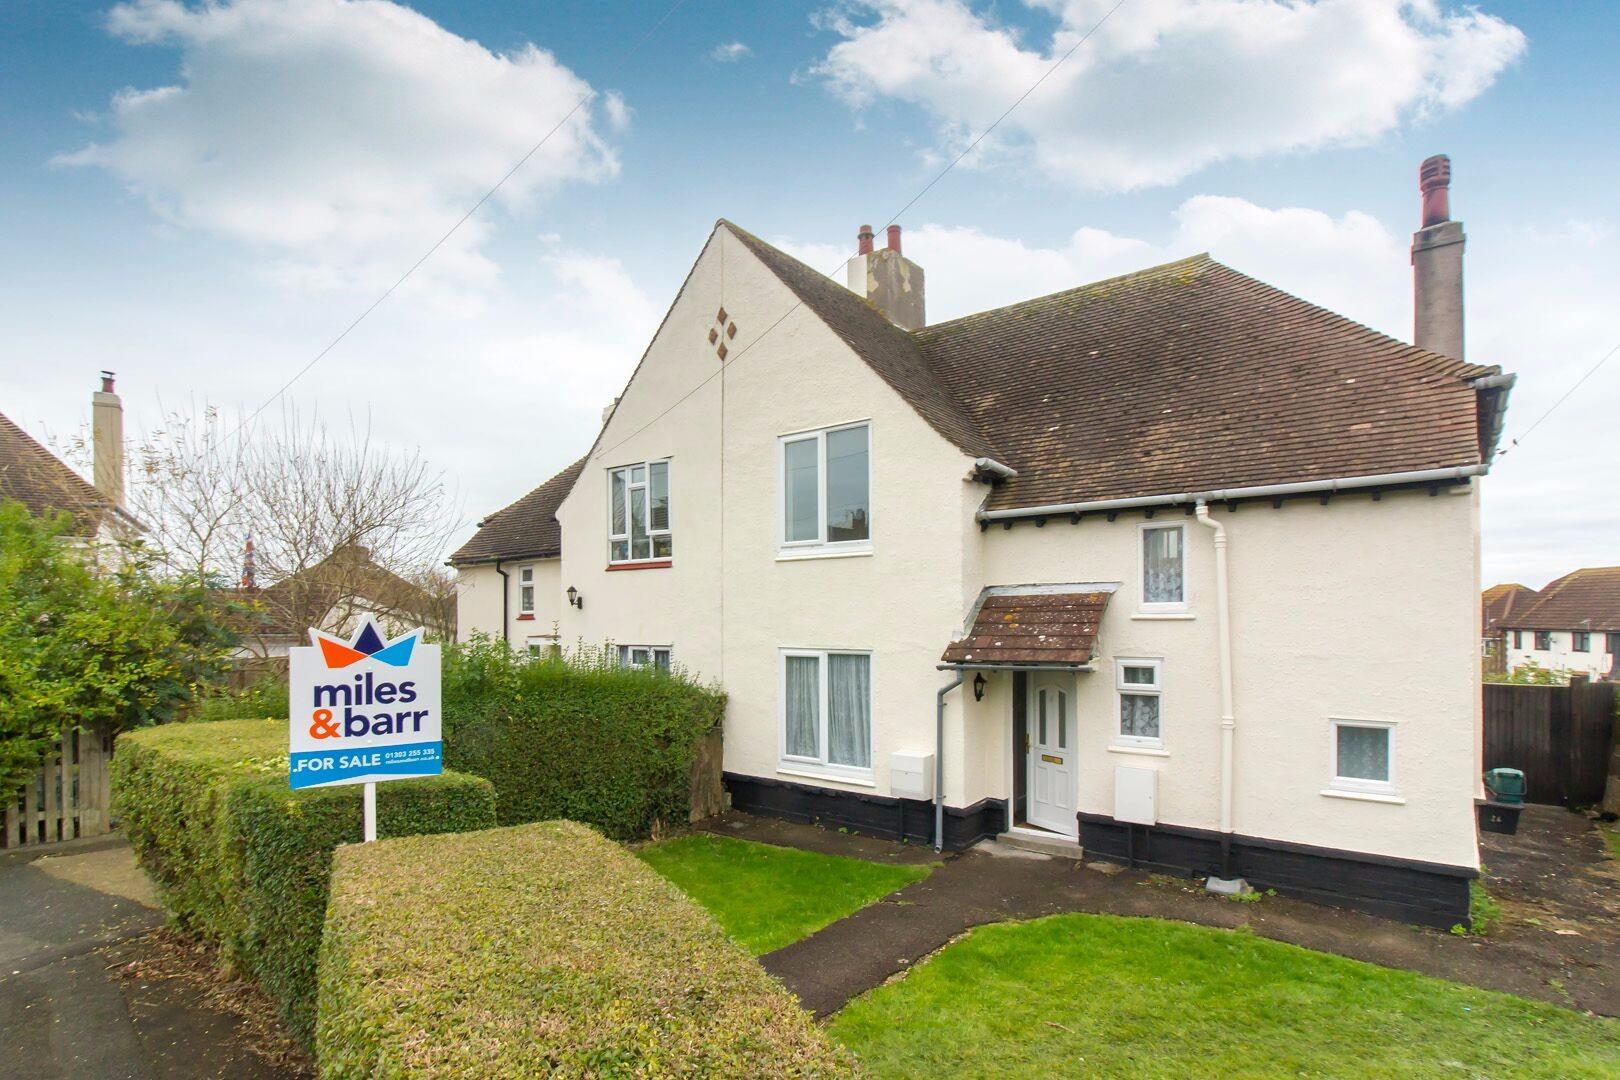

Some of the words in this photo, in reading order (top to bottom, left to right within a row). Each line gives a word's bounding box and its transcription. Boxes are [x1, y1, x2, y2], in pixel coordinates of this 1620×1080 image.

[314, 672, 417, 707] miles
[297, 757, 334, 772] FOR
[339, 753, 381, 769] SALE
[408, 749, 421, 757] 255
